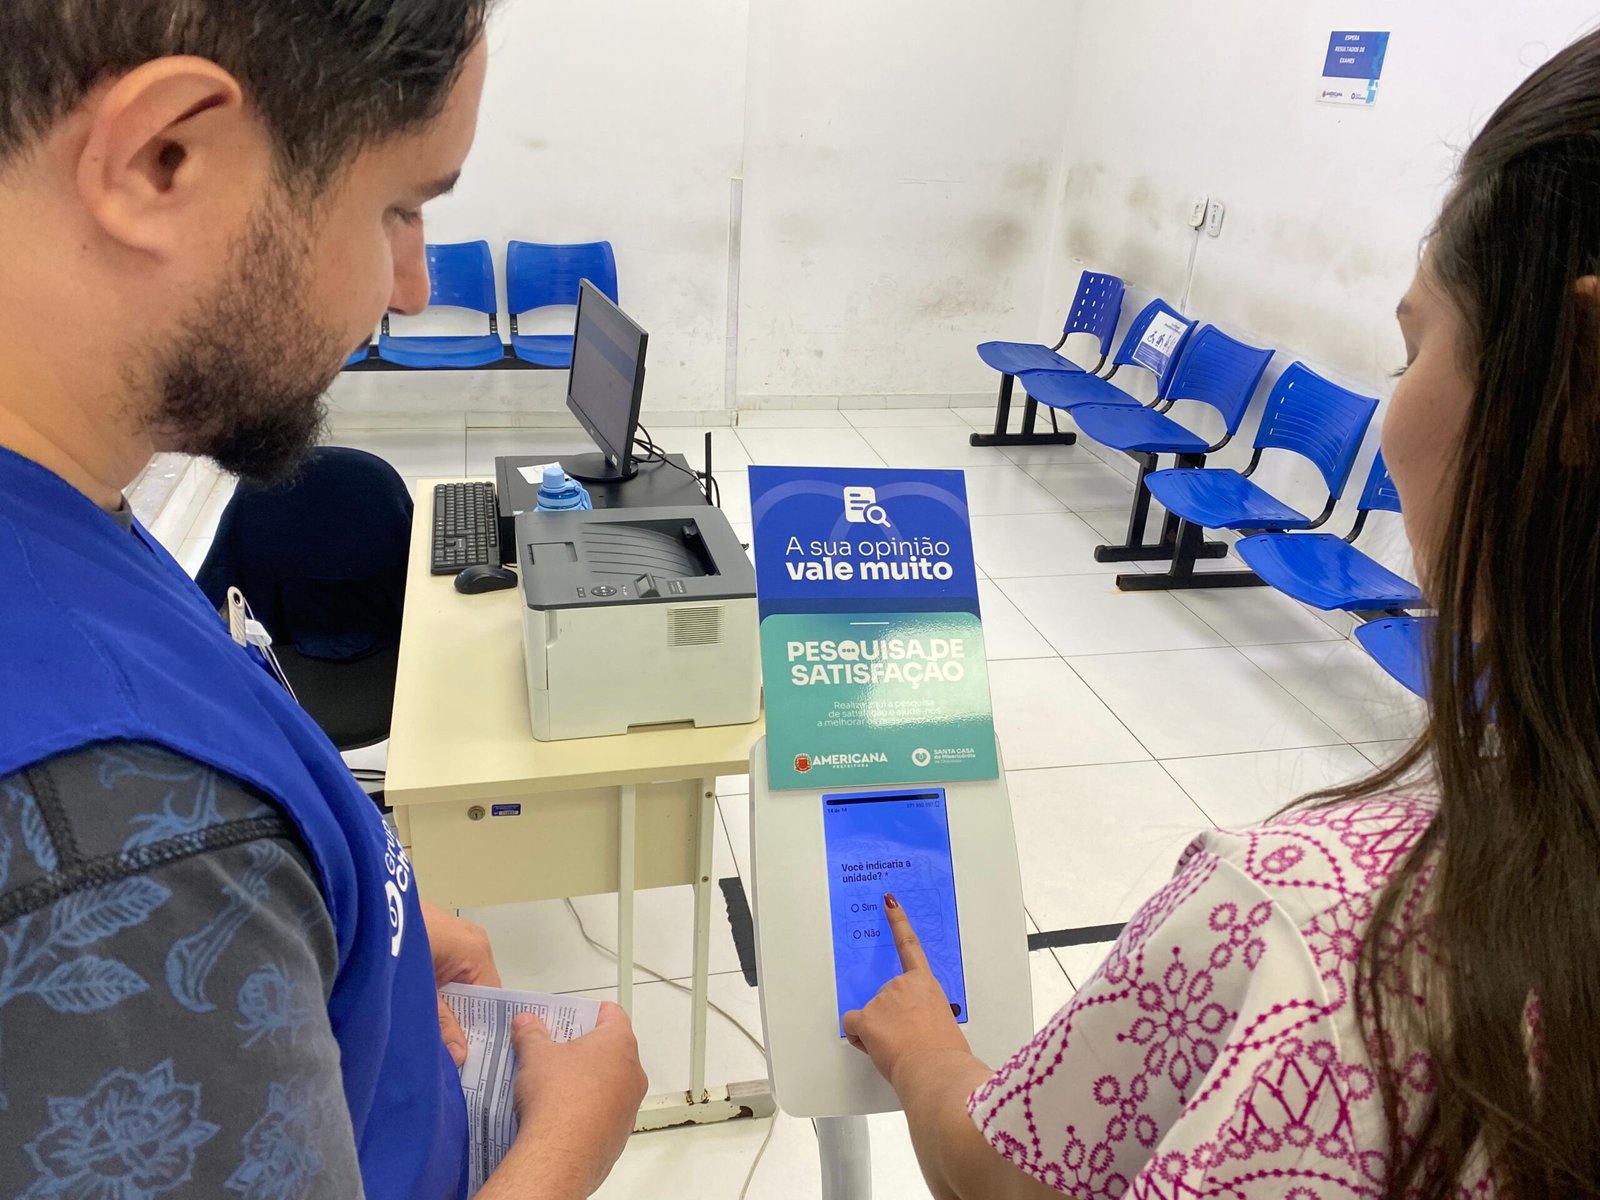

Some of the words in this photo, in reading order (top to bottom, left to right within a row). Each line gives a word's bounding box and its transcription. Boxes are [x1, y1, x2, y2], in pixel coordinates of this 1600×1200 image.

[785, 536, 805, 556] A
[810, 540, 852, 556] sua
[858, 537, 950, 561] opinião
[785, 556, 854, 580] vale
[860, 555, 953, 580] muito
[787, 639, 926, 662] PESQUISA
[929, 638, 965, 660] DE
[791, 656, 965, 690] SATISFAÇÃO
[828, 710, 841, 719] de
[816, 720, 823, 728] a
[824, 717, 866, 728] melhorar
[812, 752, 889, 766] AMERICANA
[395, 838, 411, 893] Ch
[841, 861, 864, 872] Você
[866, 859, 903, 870] indicaria
[905, 860, 911, 868] a
[842, 871, 882, 883] unidade?
[861, 903, 877, 912] Sim
[863, 928, 881, 938] Não
